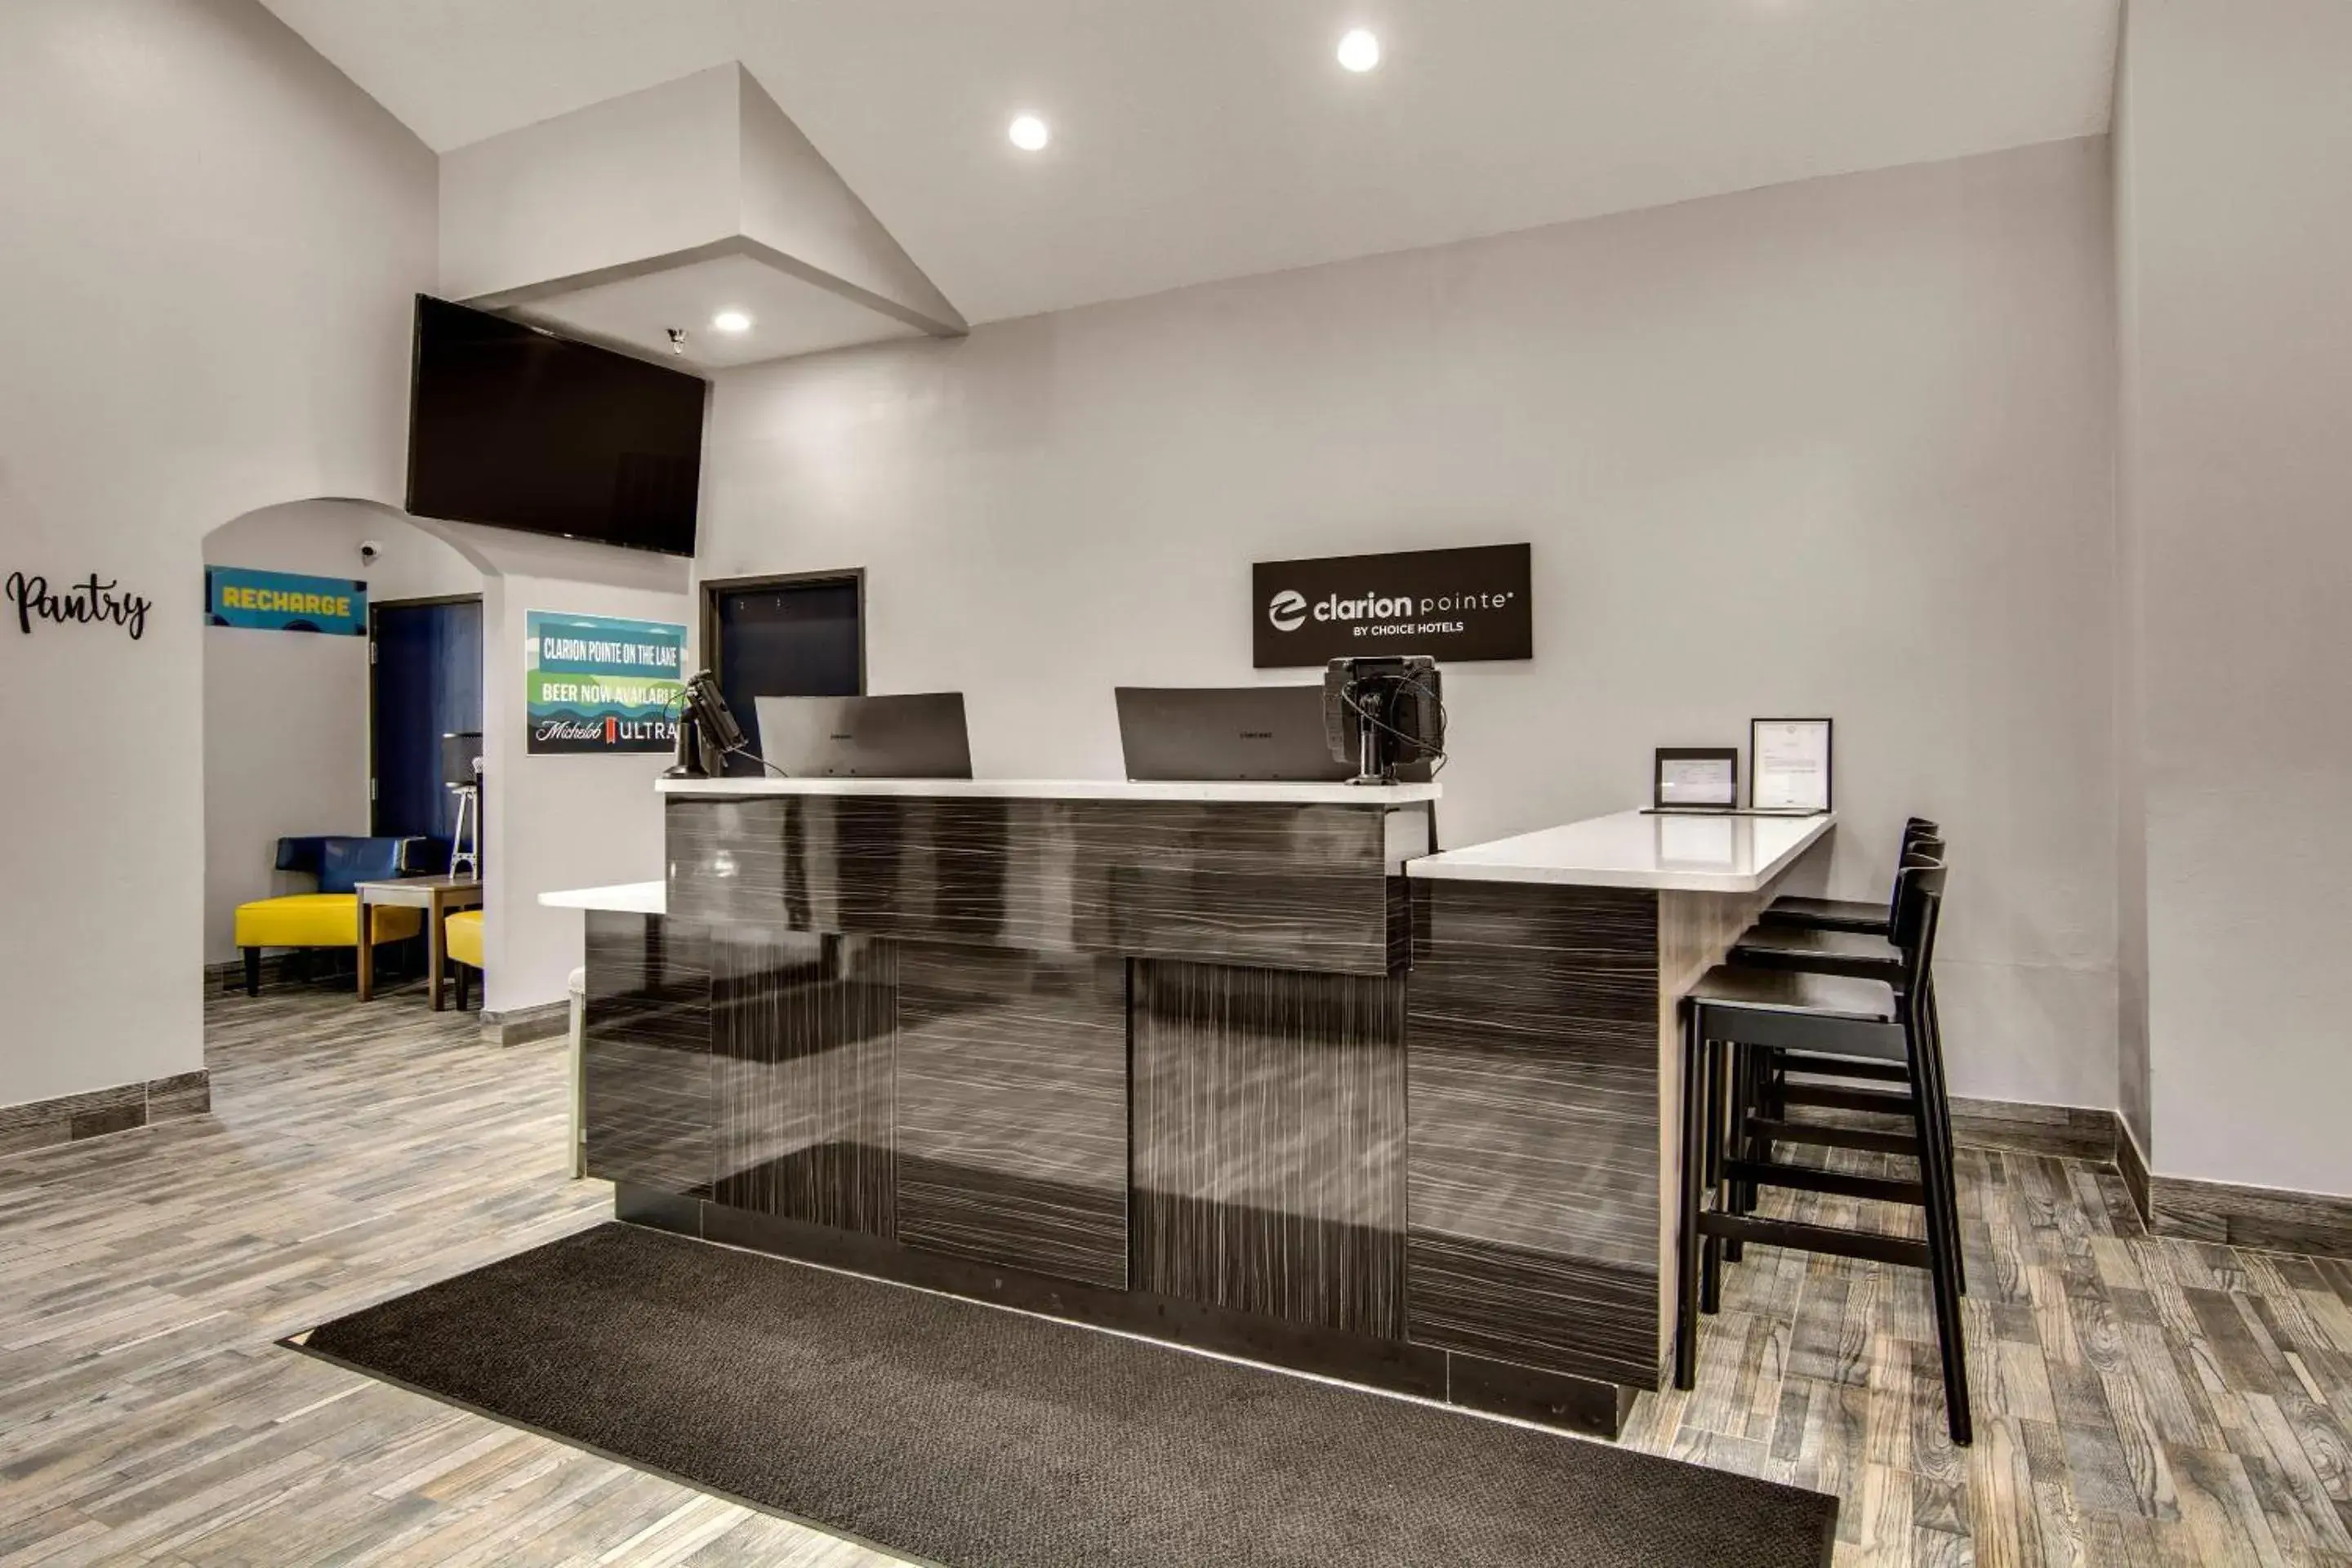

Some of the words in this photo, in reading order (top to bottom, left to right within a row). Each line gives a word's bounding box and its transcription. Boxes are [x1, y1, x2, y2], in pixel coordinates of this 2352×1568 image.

[6, 571, 152, 640] Pantry
[222, 586, 351, 617] RECHARGE
[1313, 592, 1412, 621] clarion
[1353, 626, 1368, 636] BY
[1371, 623, 1414, 635] CHOICE
[1418, 621, 1464, 634] HOTELS
[544, 637, 586, 661] CLARION
[588, 640, 621, 663] POINTE
[623, 644, 636, 665] ON
[638, 645, 654, 666] THE
[656, 647, 677, 667] LAKE
[542, 683, 577, 702] BEER
[581, 684, 612, 703] NOW
[613, 686, 678, 705] AVAILABLE
[536, 720, 602, 741] Michelob
[620, 722, 678, 740] ULTRA
